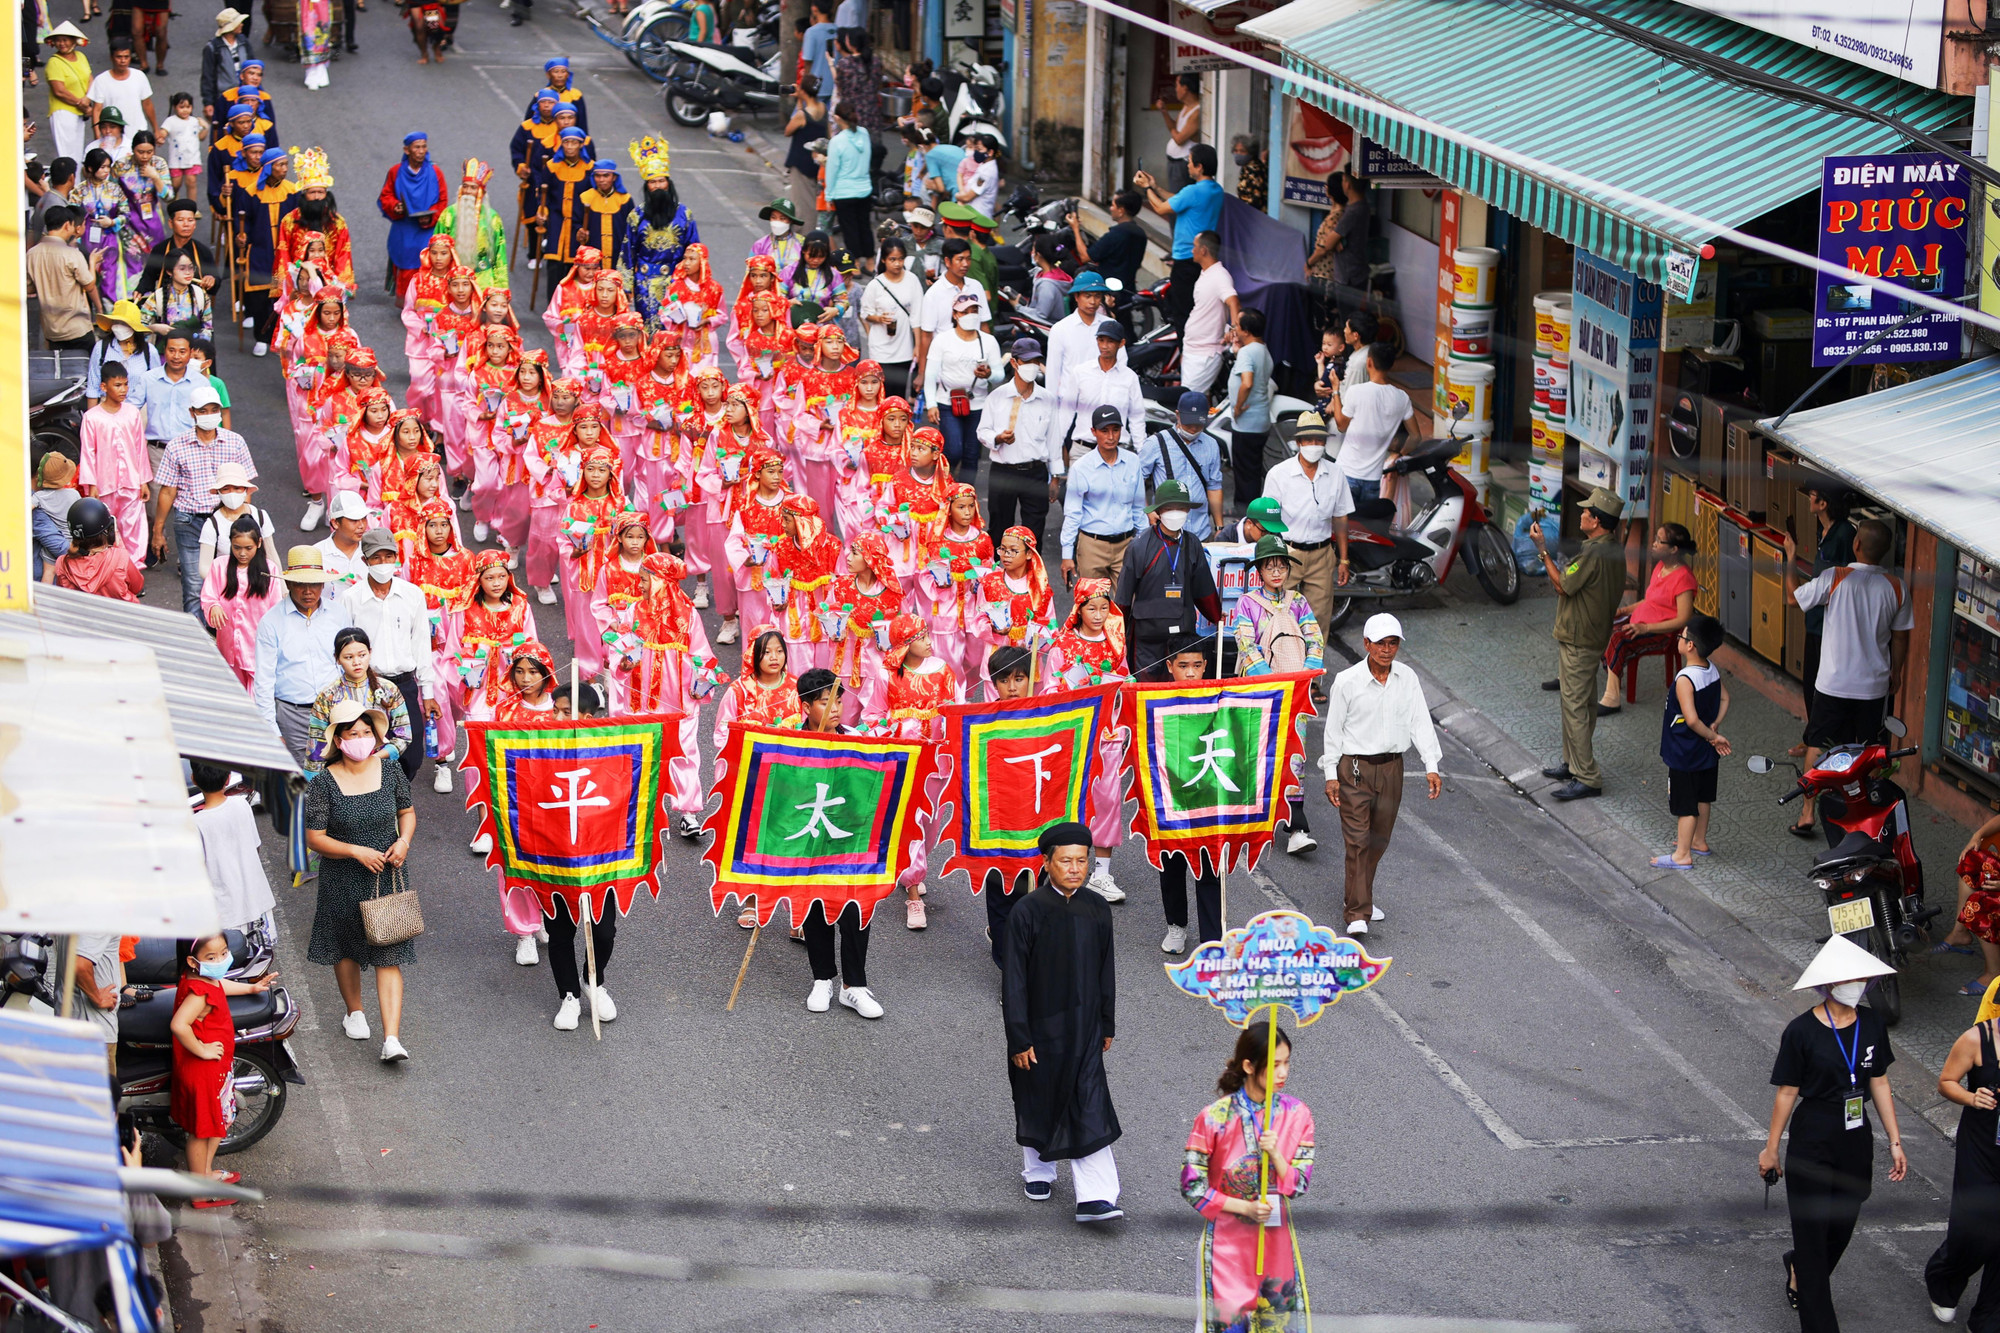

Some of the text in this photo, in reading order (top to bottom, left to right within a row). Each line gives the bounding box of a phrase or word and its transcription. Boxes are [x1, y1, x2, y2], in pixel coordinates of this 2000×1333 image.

[1833, 160, 1960, 188] ĐIỆN MÁY
[1826, 188, 1966, 234] PHÚC
[1845, 244, 1942, 278] MAI
[1817, 318, 1832, 328] ĐC:
[1834, 317, 1850, 326] 197
[1852, 316, 1877, 326] PHAN
[1846, 331, 1857, 340] ĐT
[1890, 342, 1948, 353] 0905.830.130
[1632, 410, 1648, 424] TIVI
[1181, 728, 1239, 794] 天
[1003, 742, 1064, 814] 下
[537, 767, 611, 845] 平
[784, 782, 854, 839] 太
[1835, 901, 1864, 920] 75-F1
[1834, 914, 1870, 934] 506.10
[1259, 936, 1296, 952] MÚA
[1195, 951, 1360, 972] THIÊN HẠ THÁI BÌNH
[1210, 968, 1336, 989] & HÁT SẮC BÙA
[1216, 988, 1258, 1002] (HUYỆN
[1260, 988, 1298, 998] PHONG
